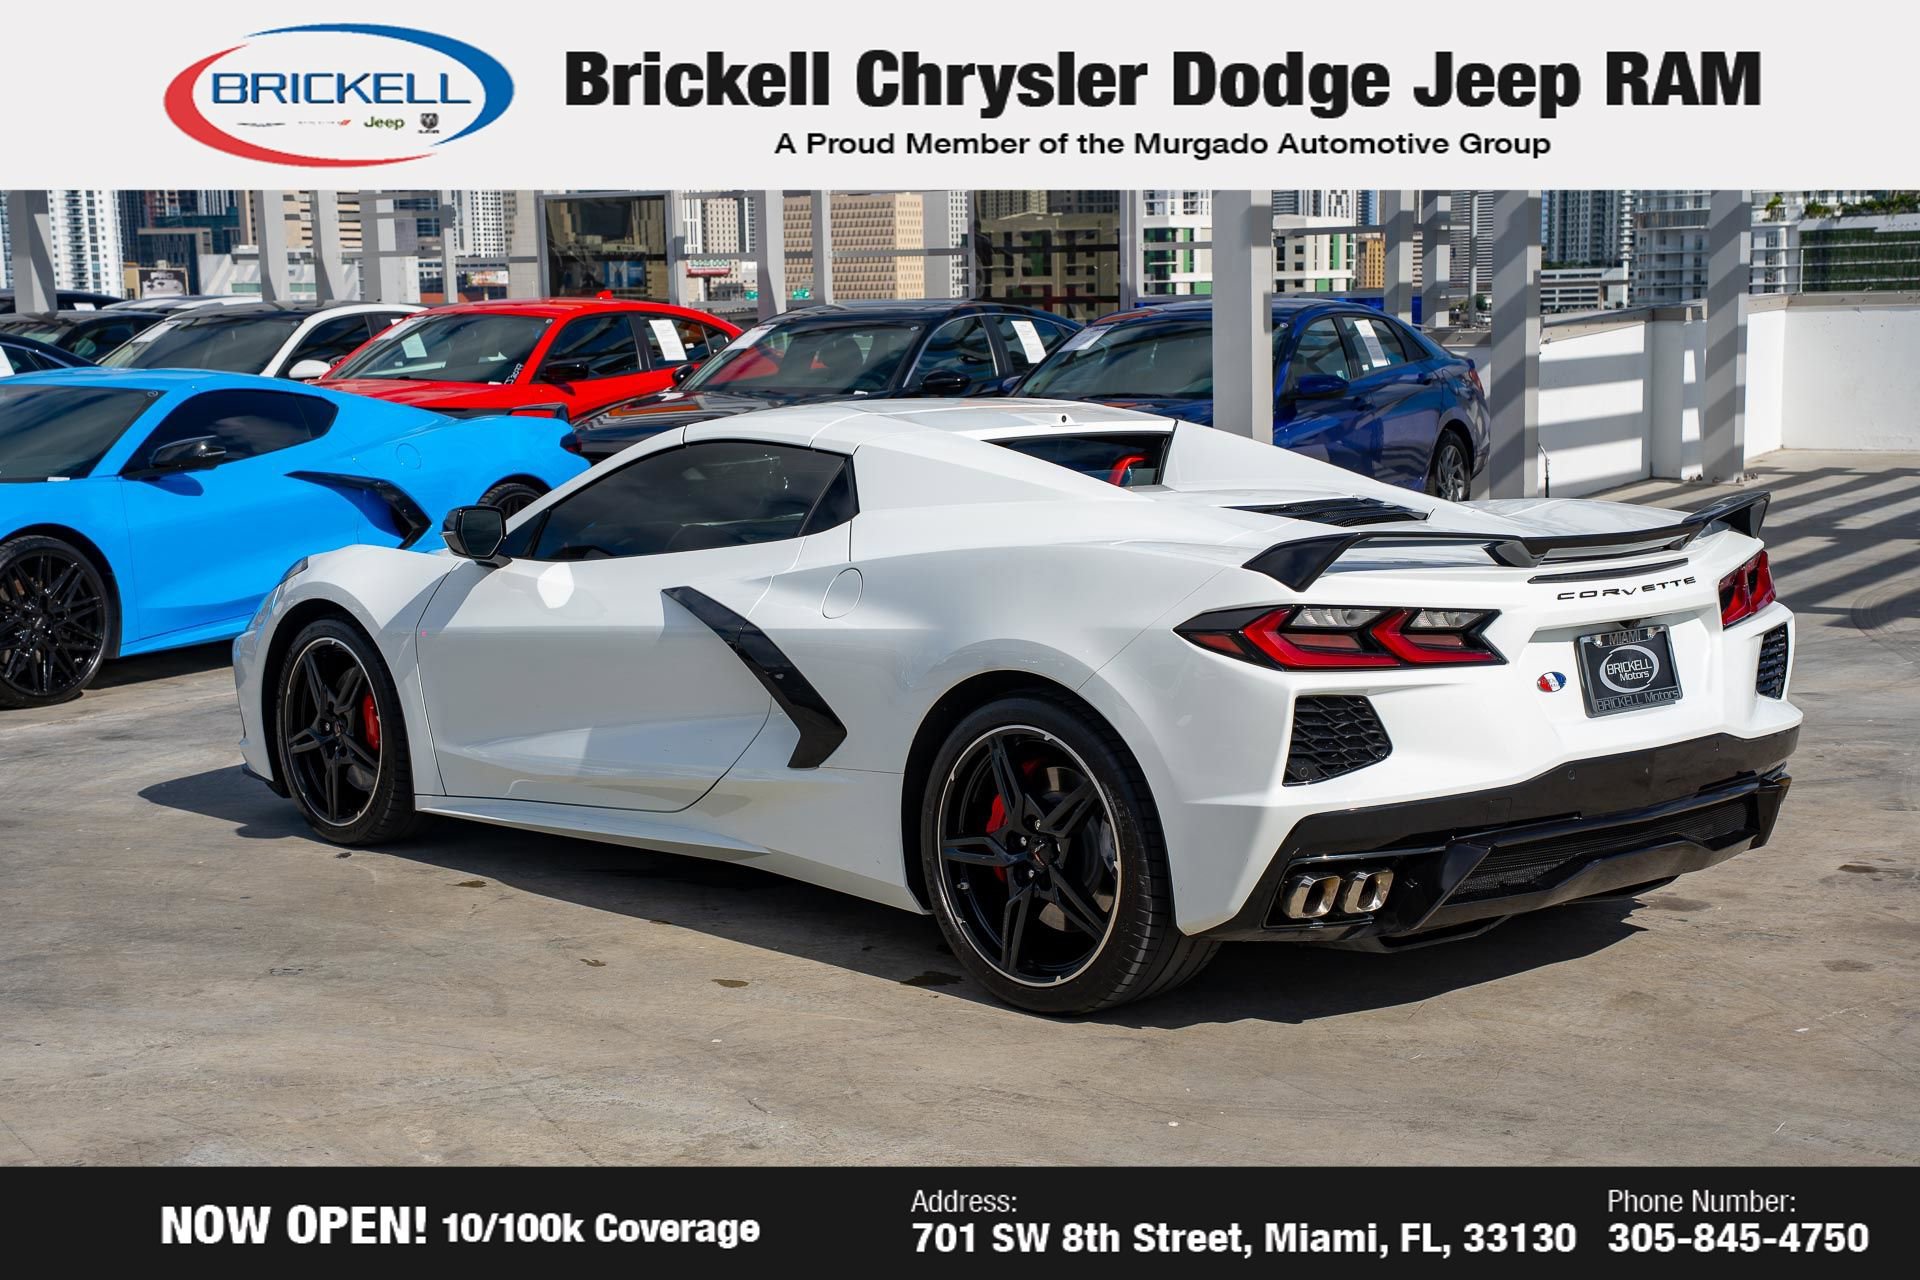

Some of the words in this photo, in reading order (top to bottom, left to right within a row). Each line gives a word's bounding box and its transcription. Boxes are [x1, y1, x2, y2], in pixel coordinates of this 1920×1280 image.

[1557, 576, 1696, 600] CORVETTE
[1608, 629, 1641, 645] MIAMI
[1606, 658, 1652, 675] BRICKELL
[1619, 670, 1650, 681] Motors
[1596, 693, 1643, 712] BRICKELL
[1645, 689, 1680, 703] Motors
